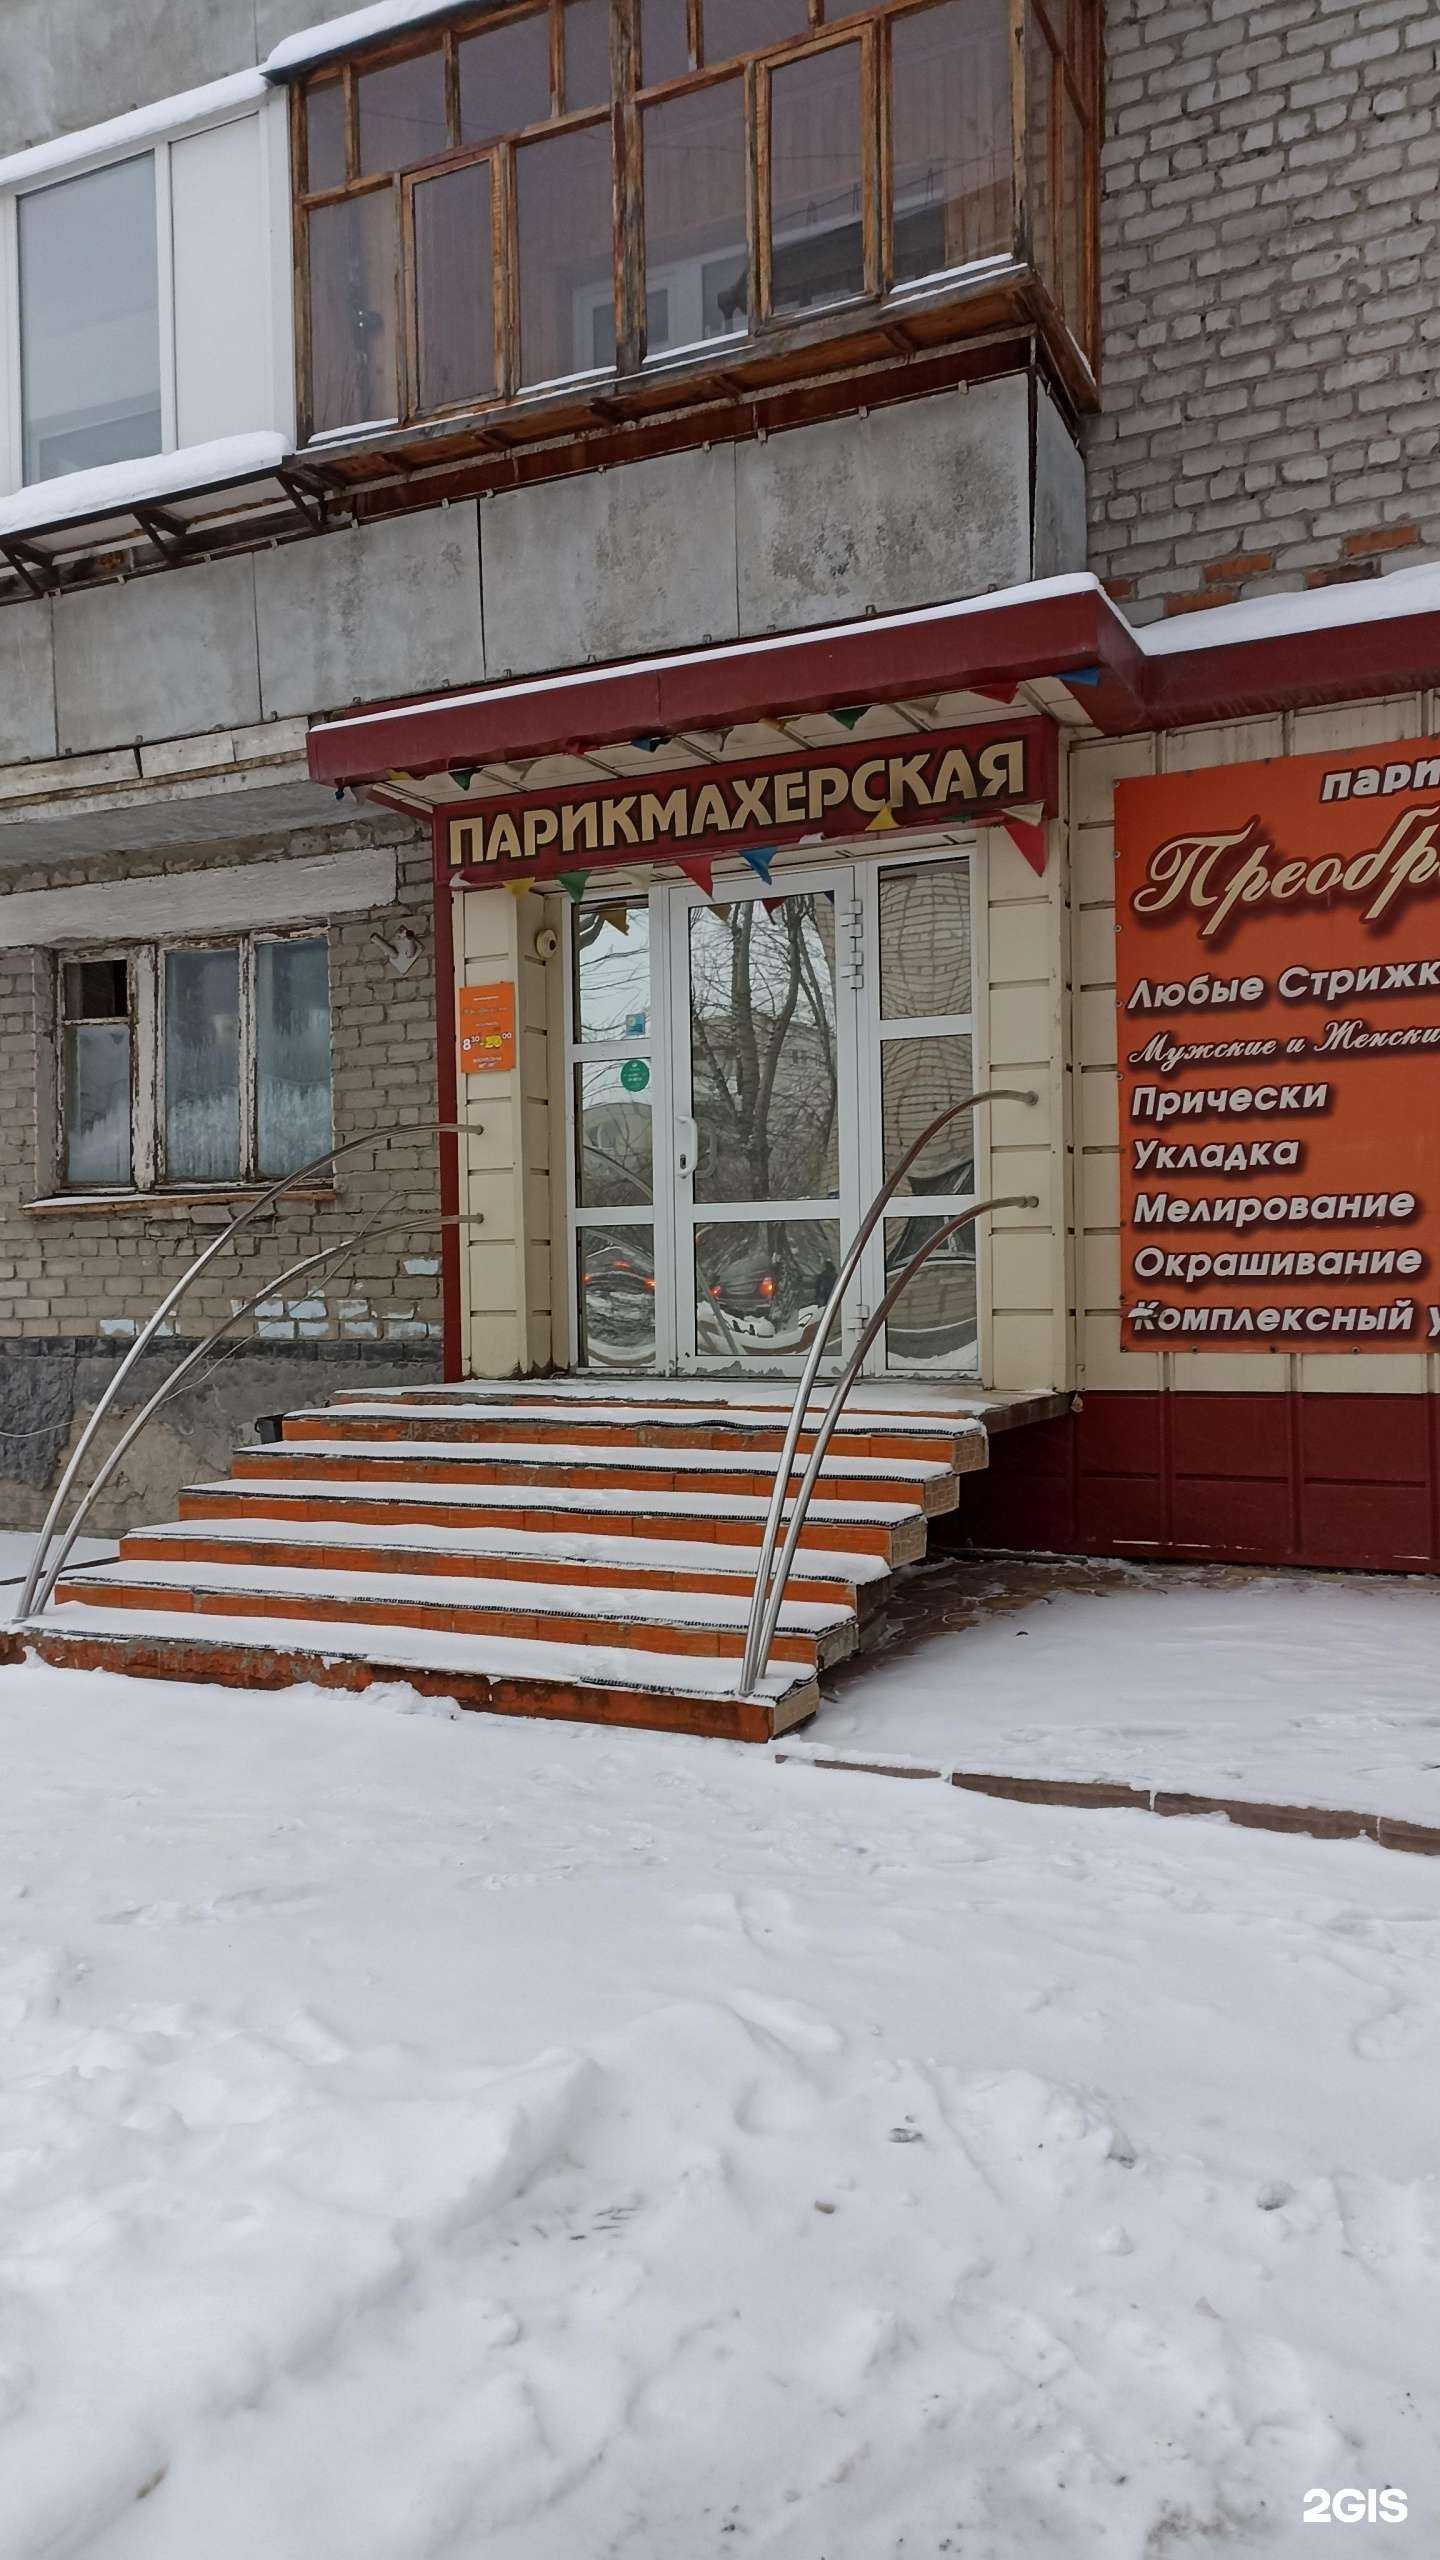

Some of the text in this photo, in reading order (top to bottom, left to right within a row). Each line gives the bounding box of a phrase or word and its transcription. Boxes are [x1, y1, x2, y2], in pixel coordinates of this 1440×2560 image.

[449, 740, 1025, 866] ПАРИКМАХЕРСКАЯ
[1127, 974, 1265, 1010] Любые
[1129, 1032, 1277, 1072] Мужские
[1286, 1037, 1306, 1053] и
[1131, 1083, 1329, 1122] Прически
[1133, 1140, 1300, 1171] Укладка
[1133, 1191, 1416, 1228] Мелирование
[1133, 1247, 1423, 1283] Окрашивание
[1133, 1299, 1415, 1332] Комплексный
